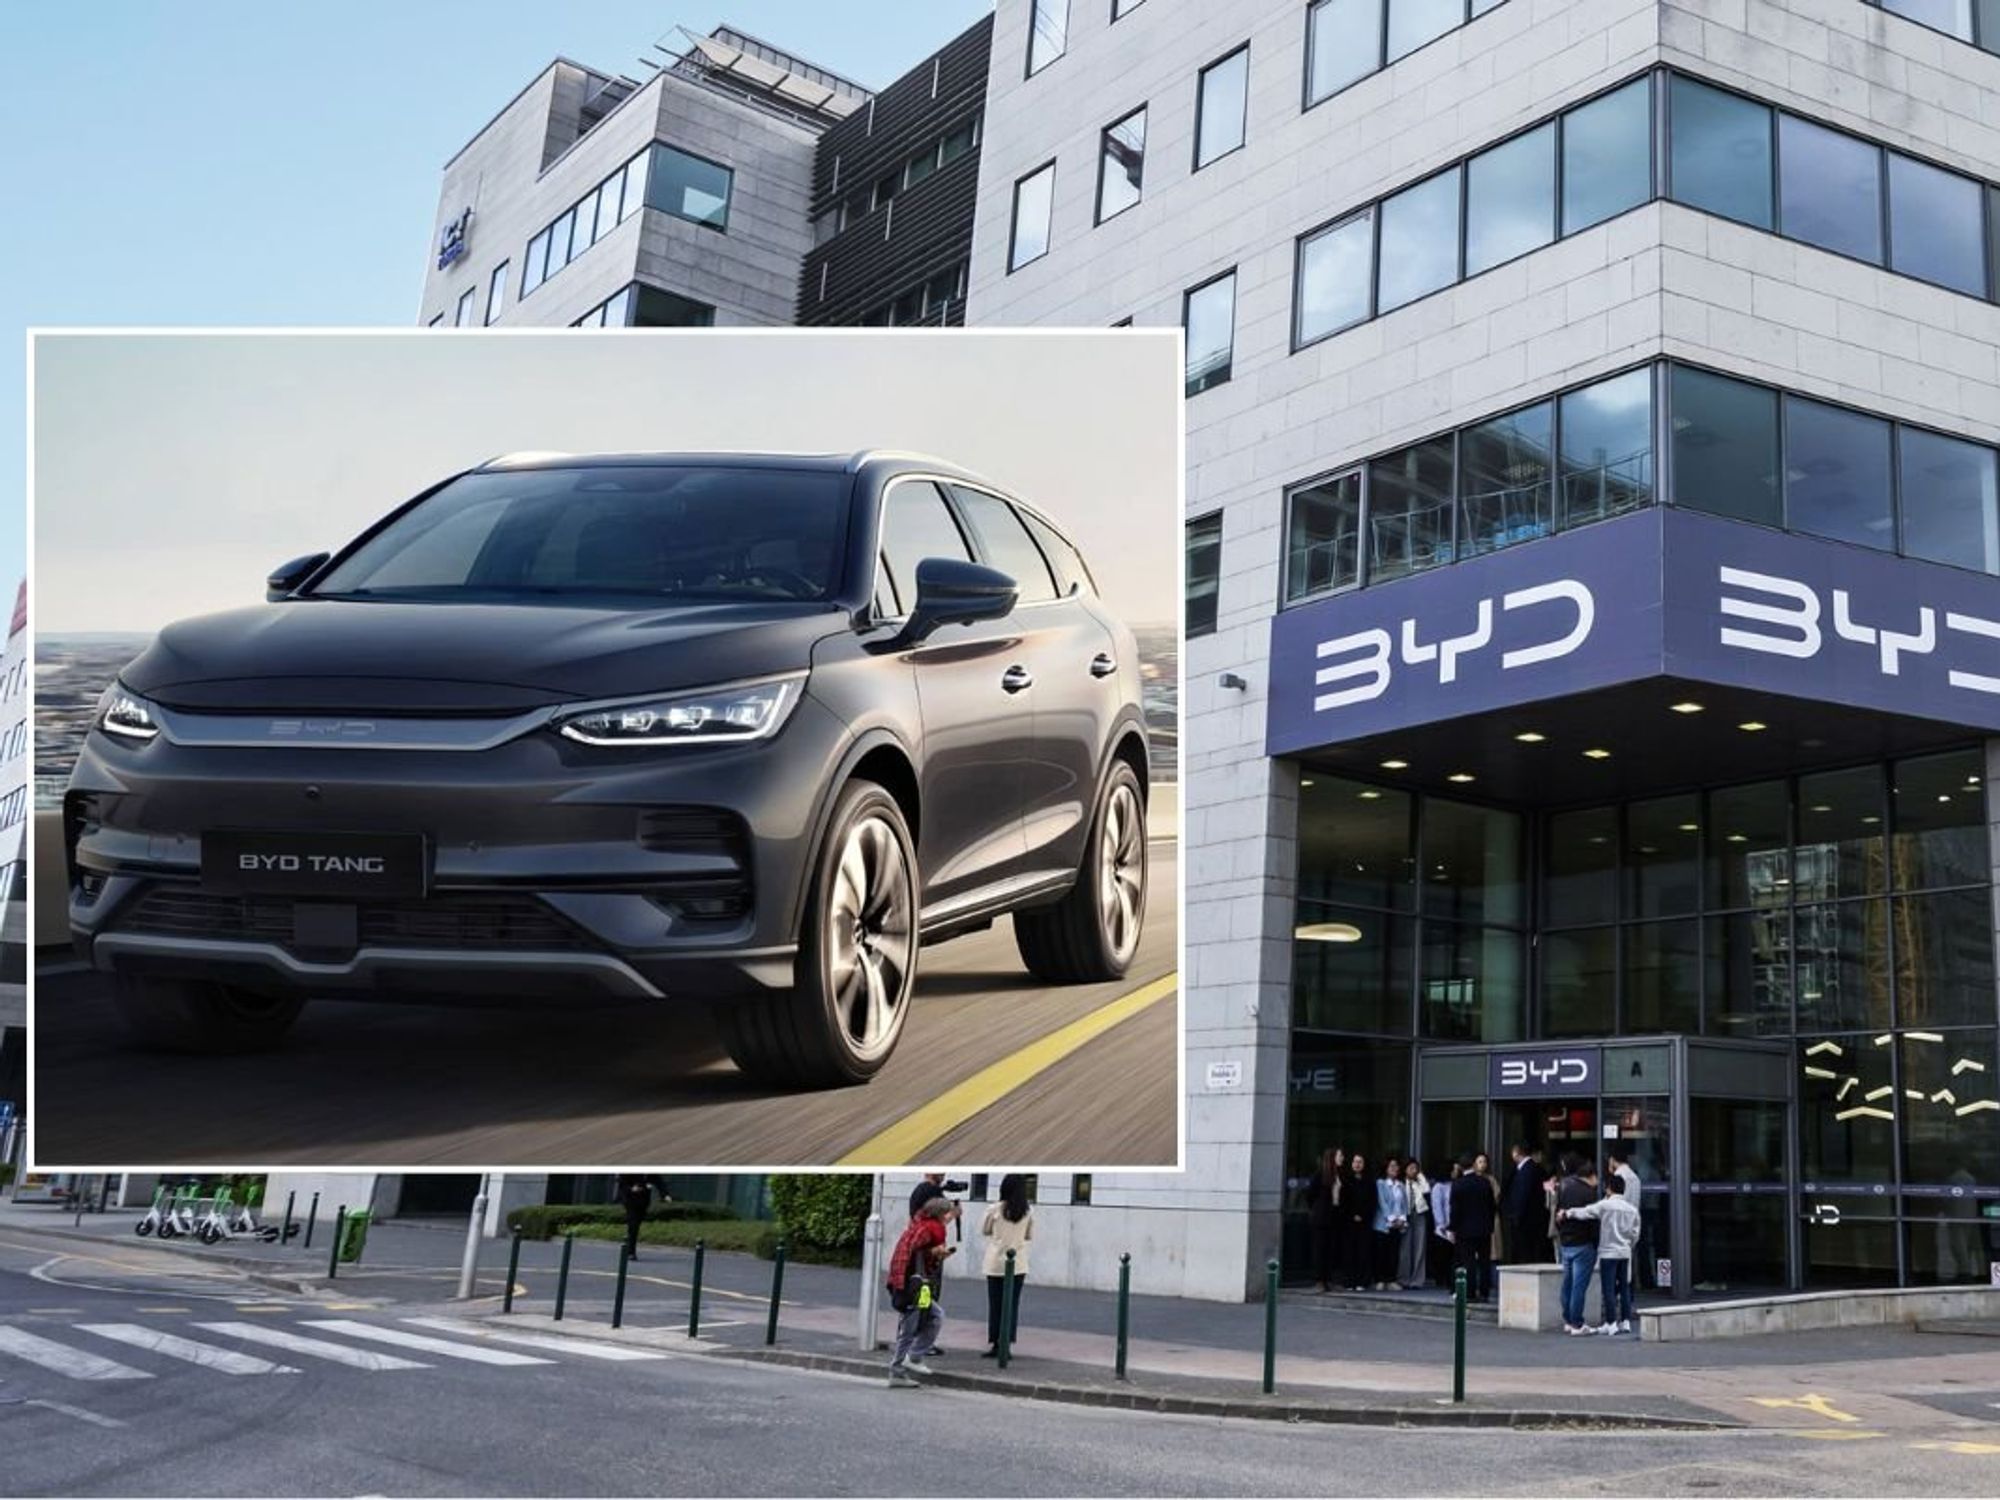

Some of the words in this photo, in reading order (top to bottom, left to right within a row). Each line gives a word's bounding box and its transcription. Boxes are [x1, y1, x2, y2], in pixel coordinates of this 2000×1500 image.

[1314, 579, 1595, 712] BYD
[239, 854, 300, 871] BYD
[307, 856, 385, 873] TANG
[1501, 1058, 1588, 1085] BYD
[1630, 1060, 1642, 1078] A
